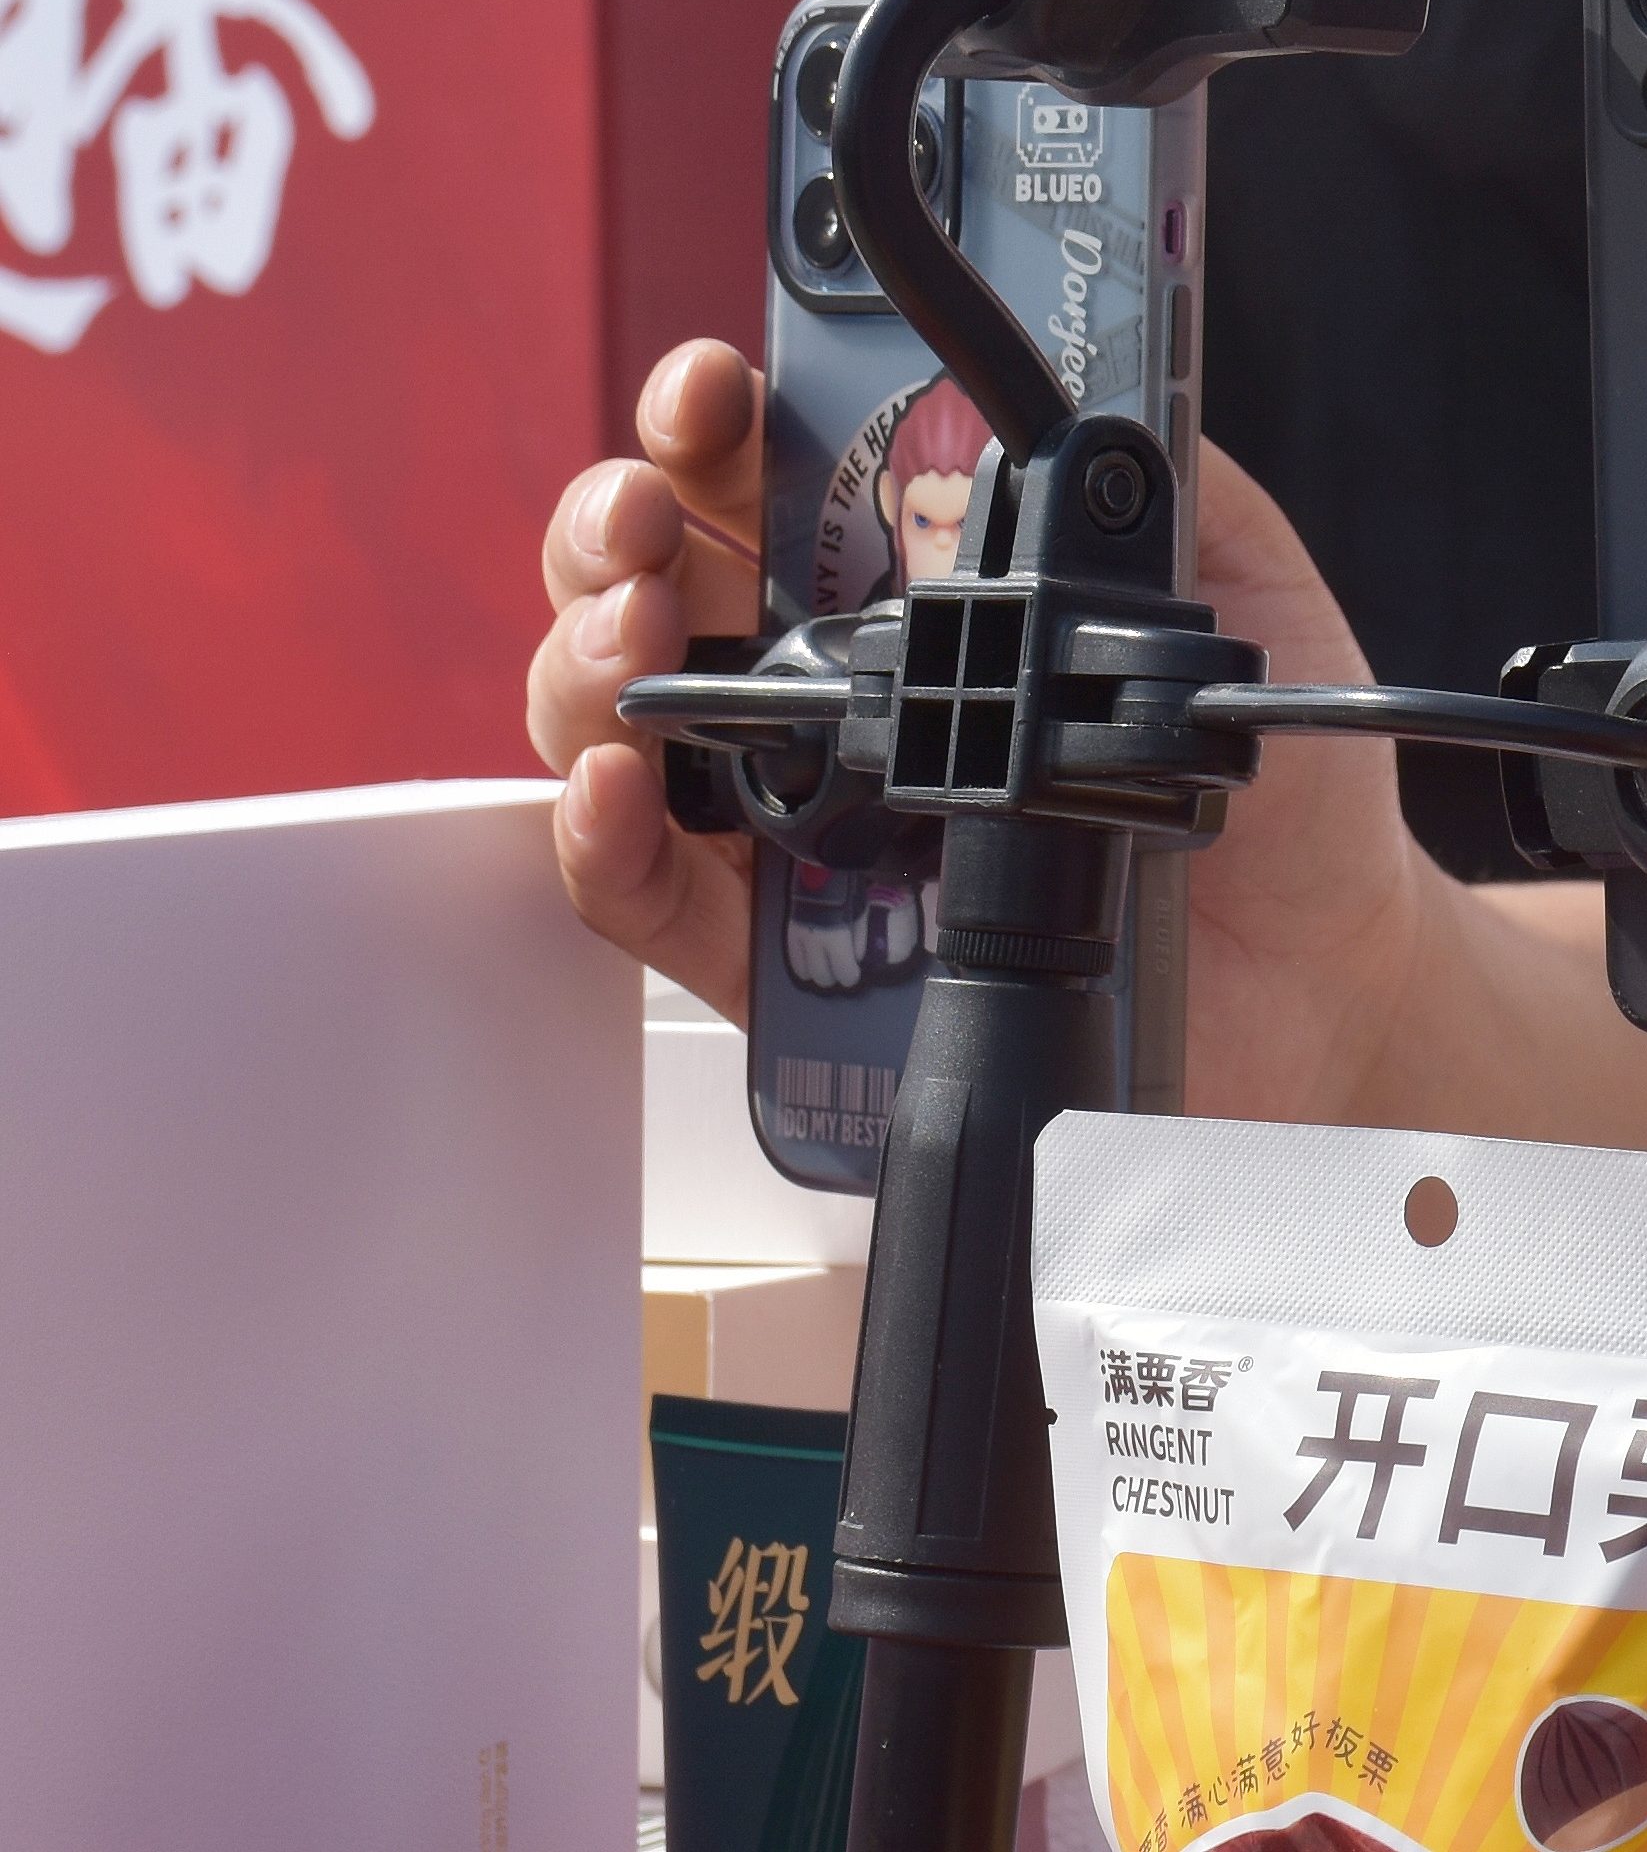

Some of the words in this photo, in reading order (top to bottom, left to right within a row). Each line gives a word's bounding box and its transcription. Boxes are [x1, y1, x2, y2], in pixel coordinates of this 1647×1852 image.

[1016, 174, 1102, 203] BLUEO
[831, 448, 869, 511] THE
[821, 520, 845, 553] IS
[816, 562, 840, 615] VY
[783, 1106, 808, 1140] DO
[811, 1110, 838, 1143] MY
[841, 1114, 888, 1149] BEST
[1100, 1349, 1233, 1412] 满栗香
[1105, 1420, 1213, 1466] RINGENT
[1112, 1475, 1235, 1526] CHESTNUT
[1178, 1711, 1399, 1830] 满心满意好板栗
